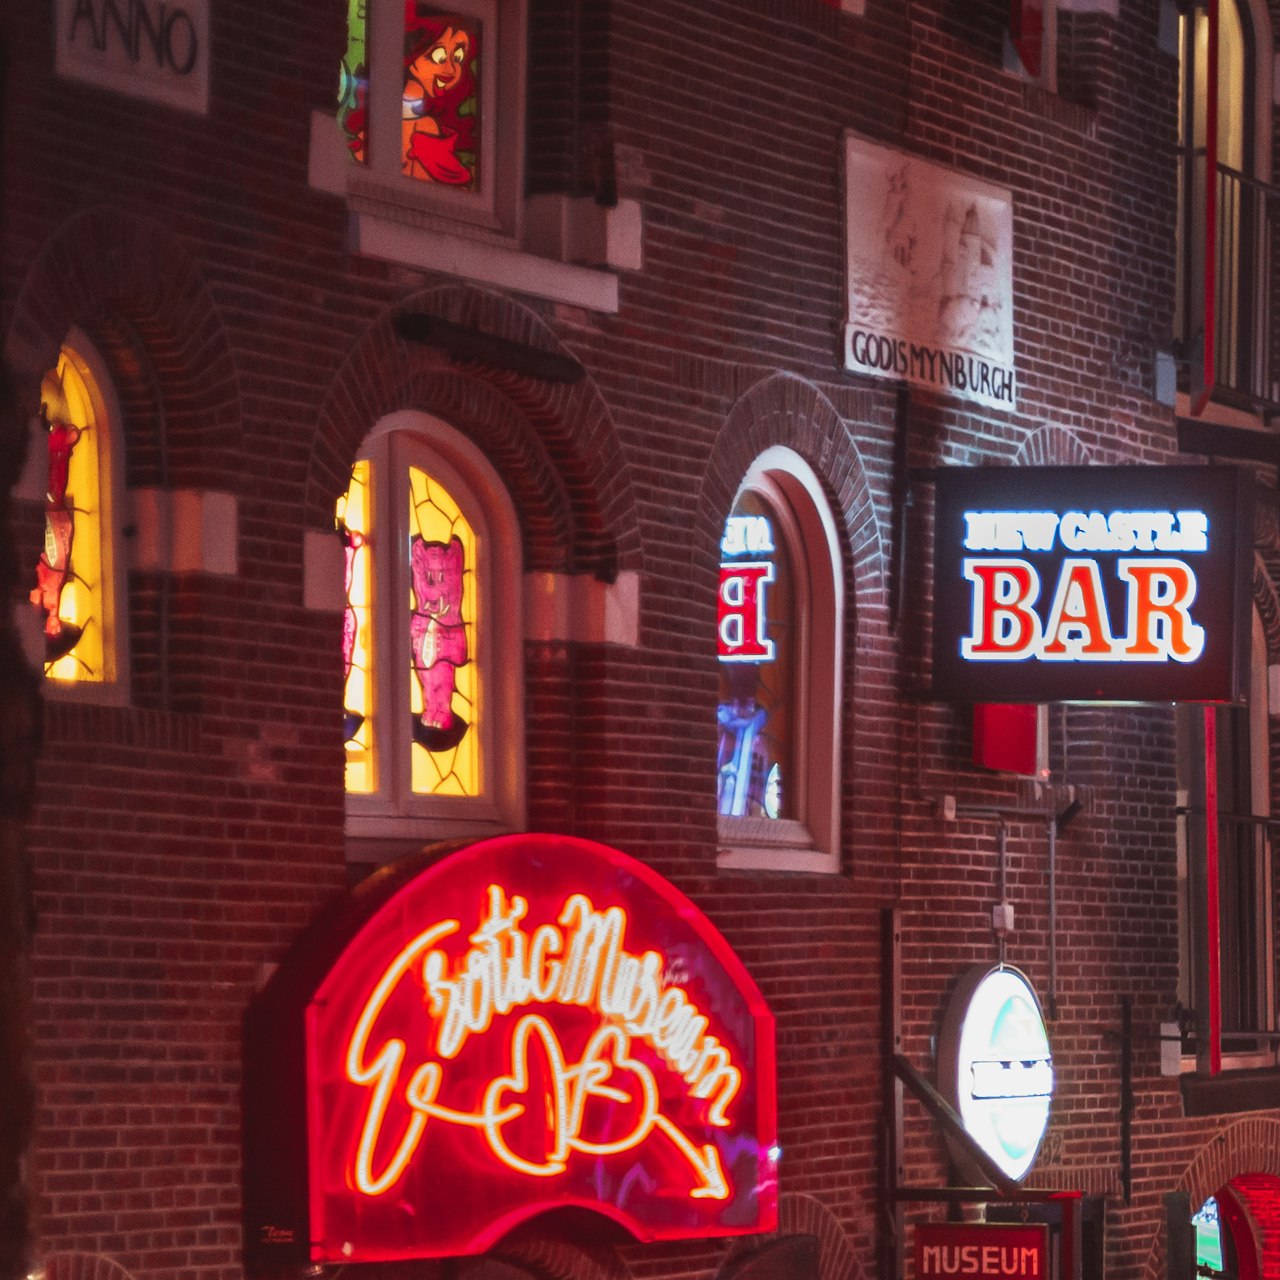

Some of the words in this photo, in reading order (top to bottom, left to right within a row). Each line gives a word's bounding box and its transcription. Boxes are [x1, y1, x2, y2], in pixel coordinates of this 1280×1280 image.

[68, 0, 198, 75] ANNO
[962, 558, 1205, 663] BAR
[558, 894, 741, 1127] Museum
[923, 1245, 1038, 1275] MUSEUM
